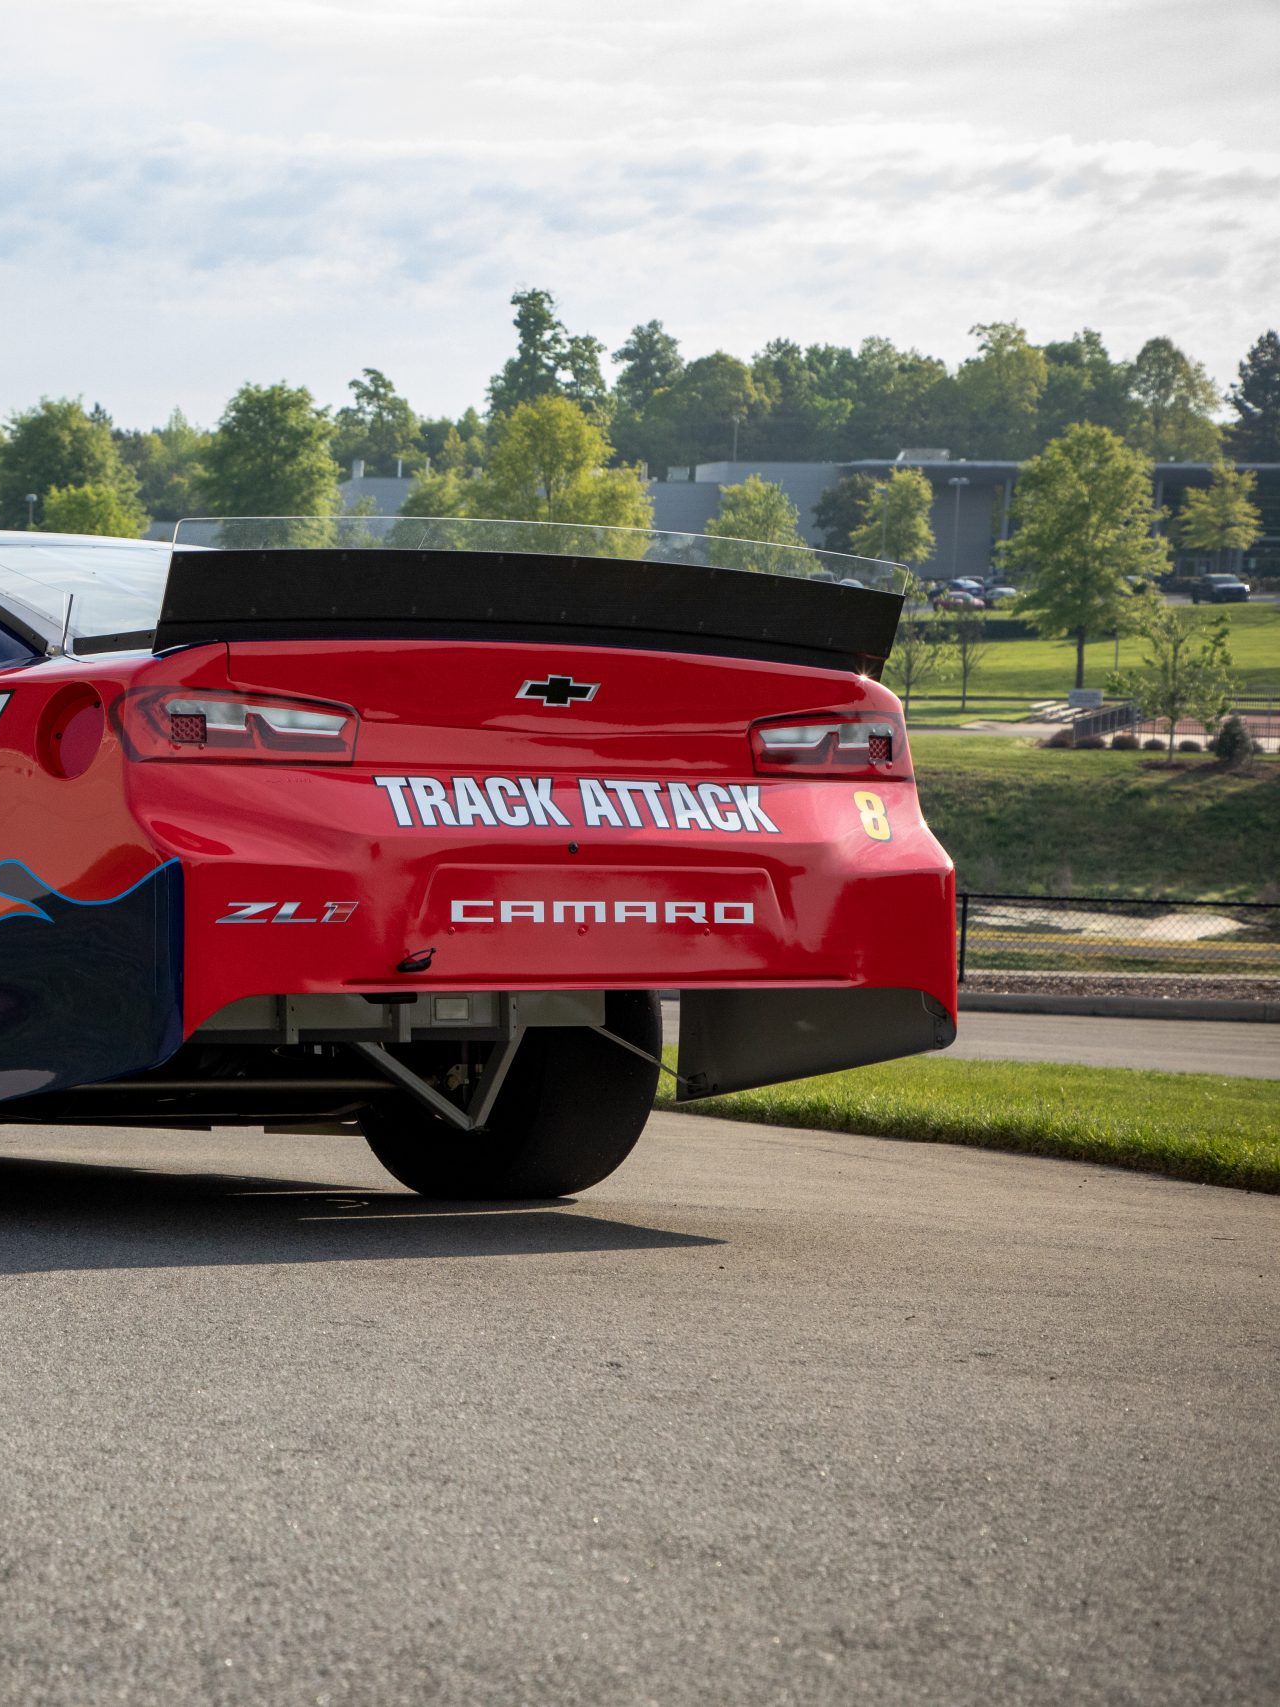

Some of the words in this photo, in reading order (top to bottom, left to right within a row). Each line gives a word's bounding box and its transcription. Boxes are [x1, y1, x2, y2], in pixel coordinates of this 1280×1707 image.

[374, 776, 572, 828] TRACK
[577, 777, 781, 834] ATTACK
[853, 791, 893, 842] 8
[215, 901, 359, 924] ZL1
[451, 900, 754, 924] CAMARO
